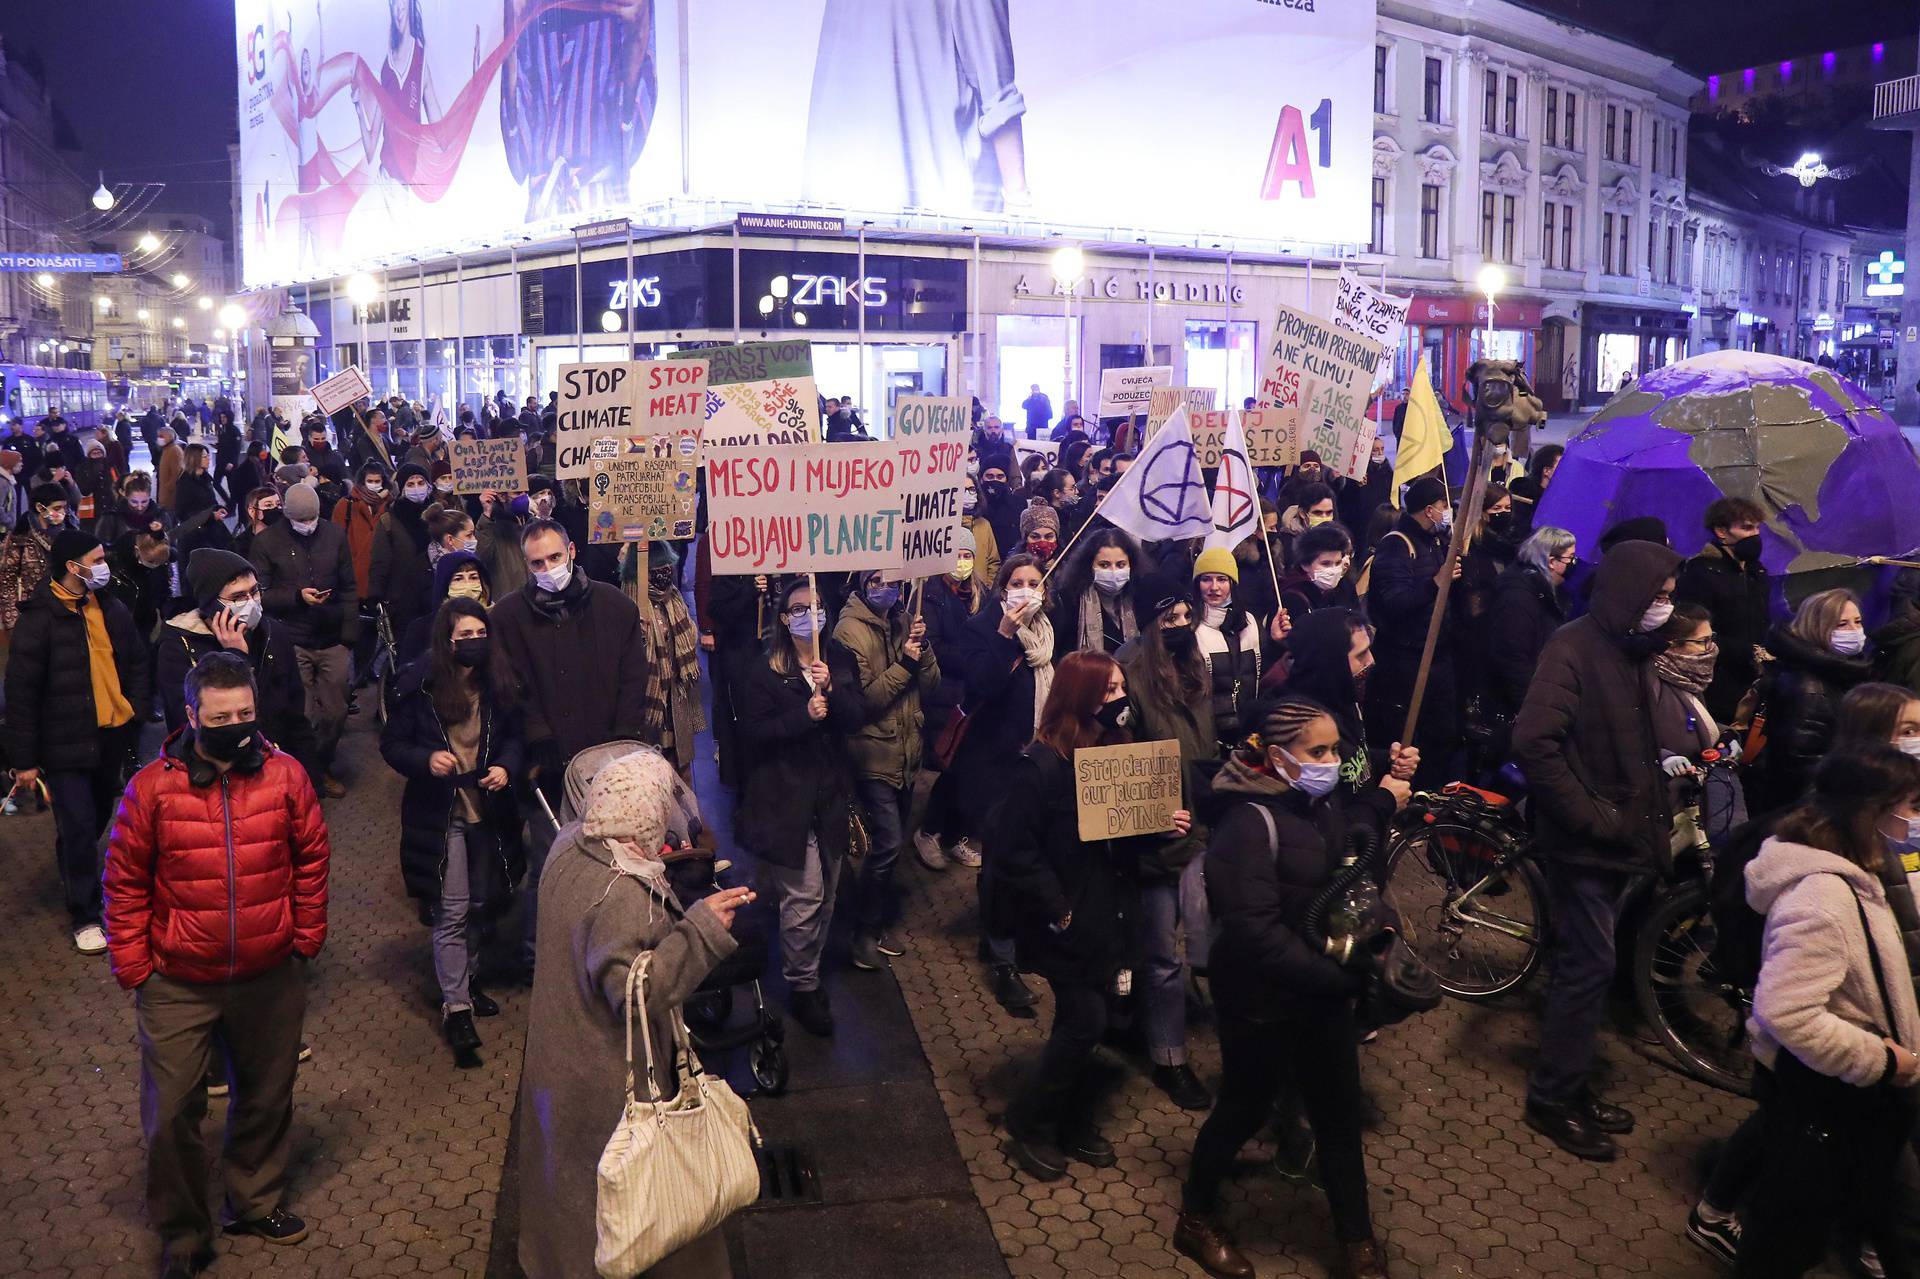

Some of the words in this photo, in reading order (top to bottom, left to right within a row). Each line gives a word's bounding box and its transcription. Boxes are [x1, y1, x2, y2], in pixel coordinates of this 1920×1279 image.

[247, 24, 265, 86] 5G
[1260, 98, 1332, 201] A1
[740, 216, 842, 232] WWW.ANIC-HOLDING.COM
[17, 255, 82, 268] PONAŠATI
[792, 274, 887, 306] ZAKS
[1137, 280, 1246, 303] HOLDING
[394, 326, 408, 334] PARIS
[1276, 310, 1329, 349] PROMJENI
[1328, 334, 1380, 374] PREHRANU
[564, 367, 627, 400] STOP
[649, 366, 704, 390] STOP
[650, 392, 703, 418] MEAT
[1113, 391, 1151, 400] PODUZEĆ
[1263, 378, 1299, 408] MESA
[558, 406, 632, 432] CLIMATE
[785, 398, 805, 420] 9kg
[899, 404, 924, 435] GO
[927, 404, 966, 435] VEGAN
[1311, 396, 1360, 432] ŽITARICA
[559, 445, 591, 469] CHA
[608, 460, 640, 471] UNIŠTIMO
[899, 449, 921, 477] TO
[927, 442, 964, 474] STOP
[613, 482, 664, 493] HOMOFOBIJU
[709, 457, 779, 497] MESO
[789, 459, 796, 492] I
[806, 458, 894, 498] MLIJEKO
[622, 506, 634, 516] NE
[901, 487, 959, 523] LIMATE
[712, 516, 802, 568] UBIJAJU
[807, 510, 902, 556] PLANET
[903, 525, 953, 561] HANGE
[1079, 759, 1120, 784] Stop
[1081, 784, 1111, 806] our
[1112, 778, 1166, 807] planet
[1107, 803, 1171, 835] DYING
